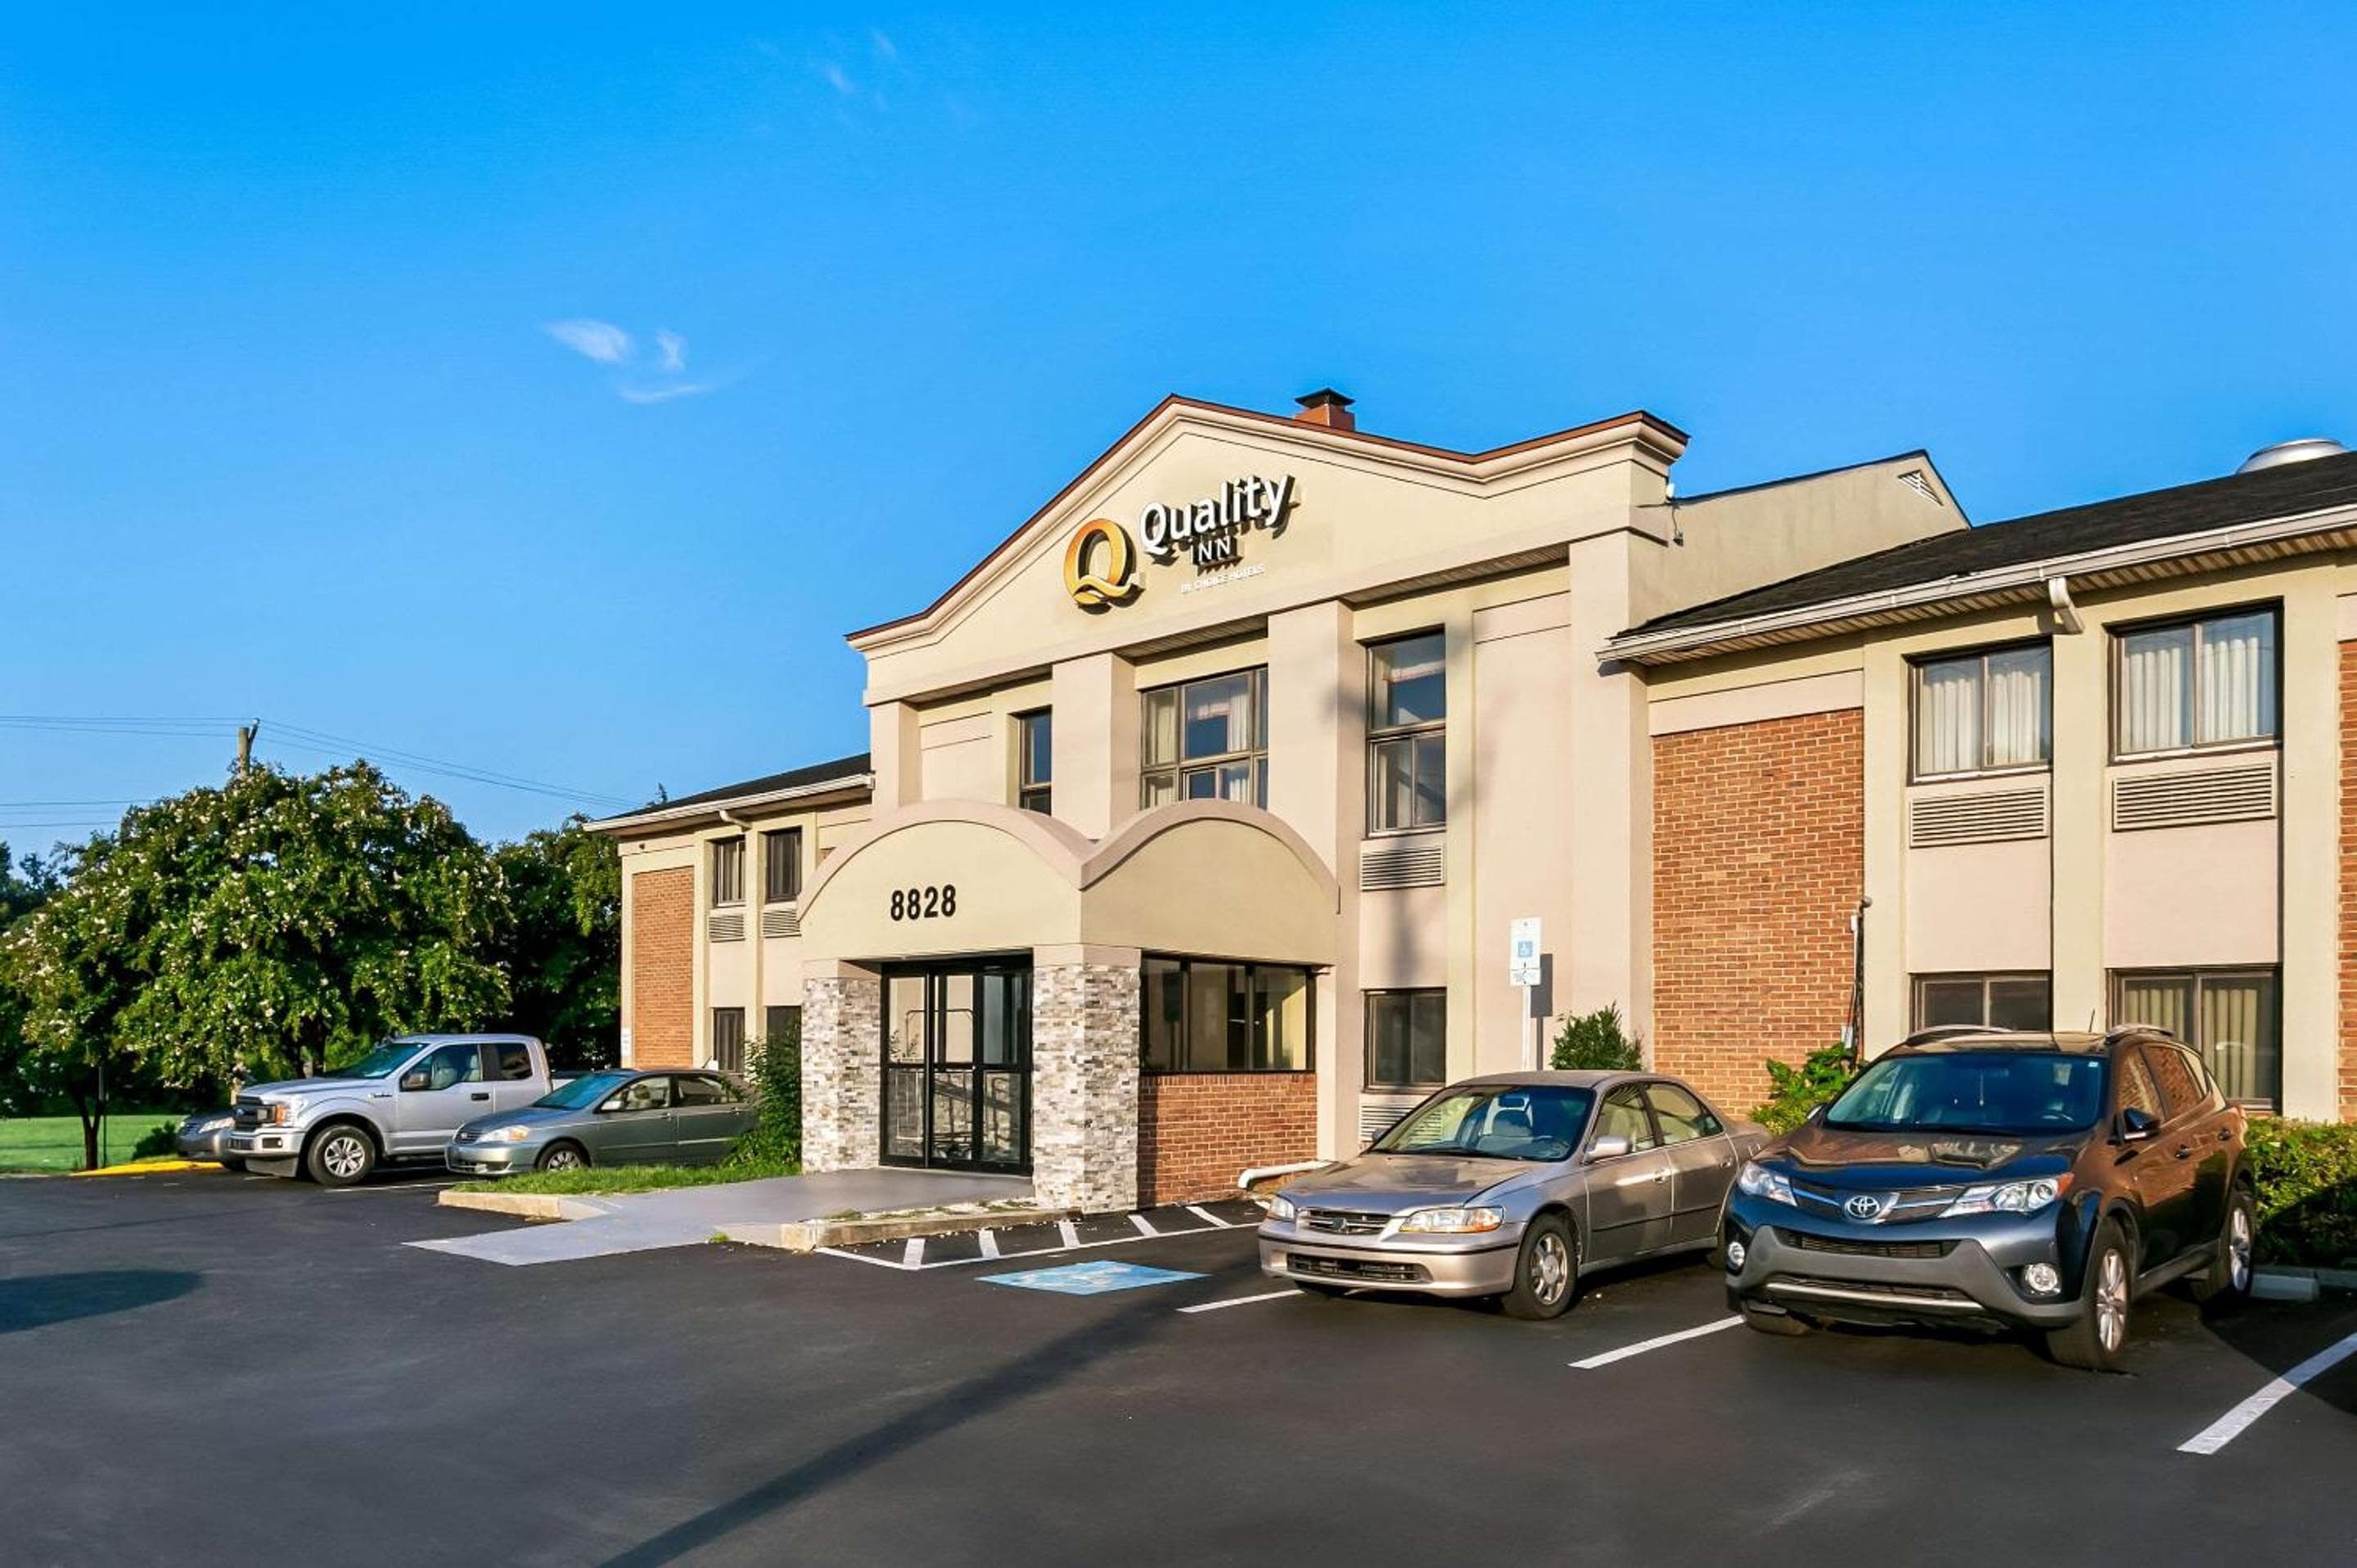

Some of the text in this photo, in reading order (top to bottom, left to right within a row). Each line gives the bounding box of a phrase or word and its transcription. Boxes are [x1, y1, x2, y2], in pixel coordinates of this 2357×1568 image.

[1140, 474, 1293, 555] Quality
[1064, 518, 1141, 606] Q
[1189, 535, 1231, 563] INN
[890, 884, 957, 921] 8828
